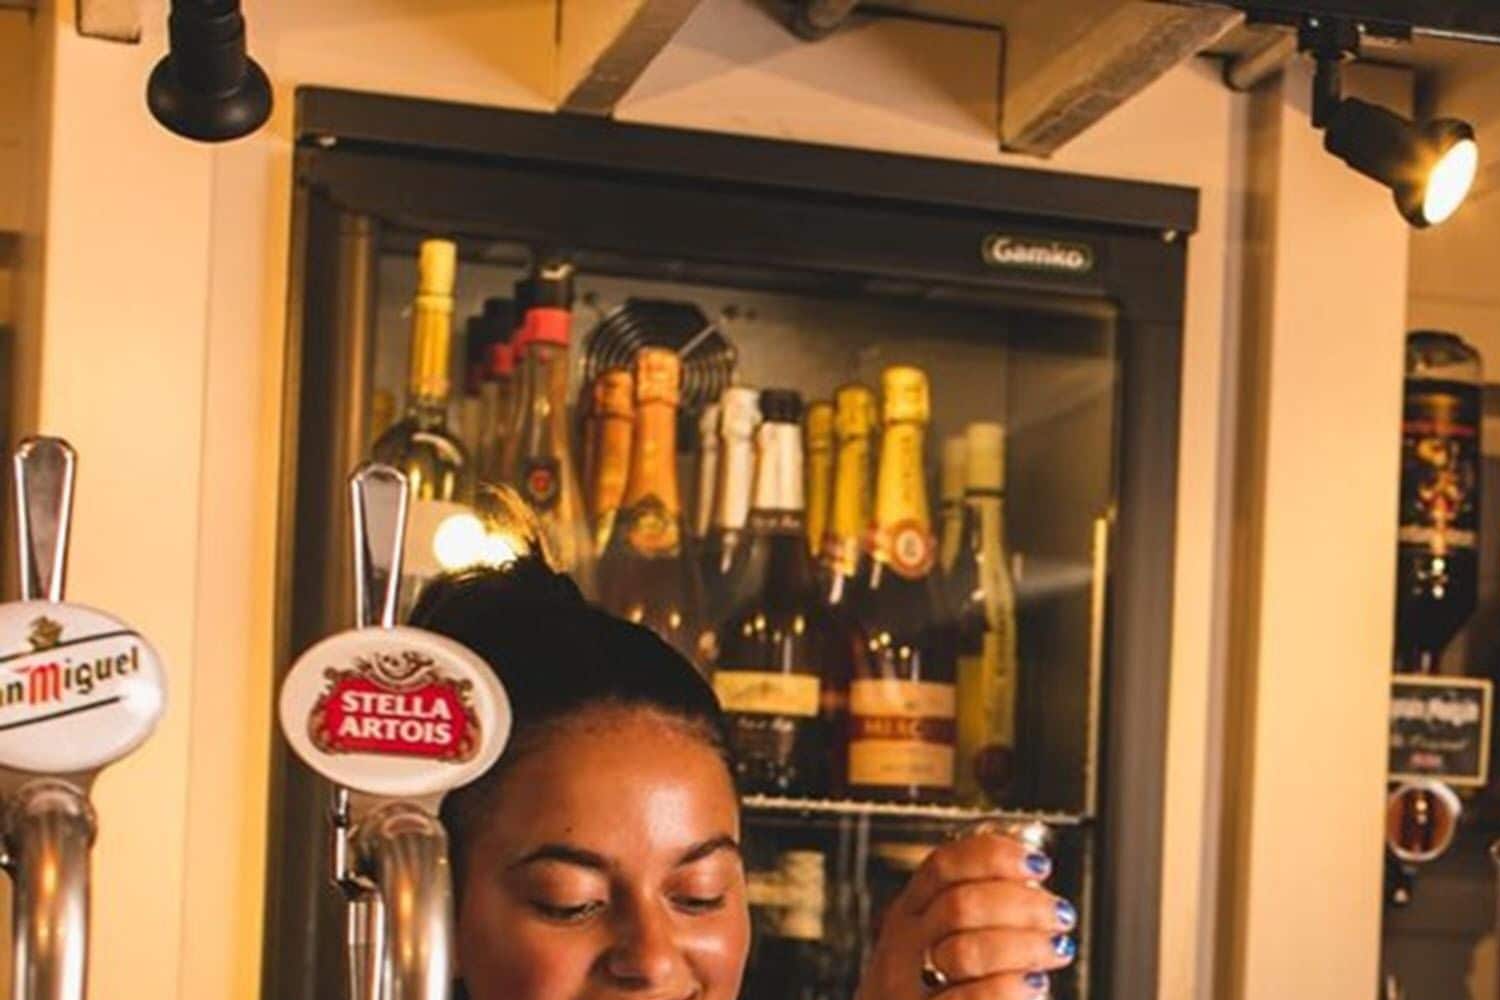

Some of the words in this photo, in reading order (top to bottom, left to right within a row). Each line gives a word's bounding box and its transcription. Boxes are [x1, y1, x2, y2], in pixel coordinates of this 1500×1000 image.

[27, 644, 140, 706] Miguel
[341, 690, 453, 720] STELLA
[337, 715, 453, 745] ARTOIS
